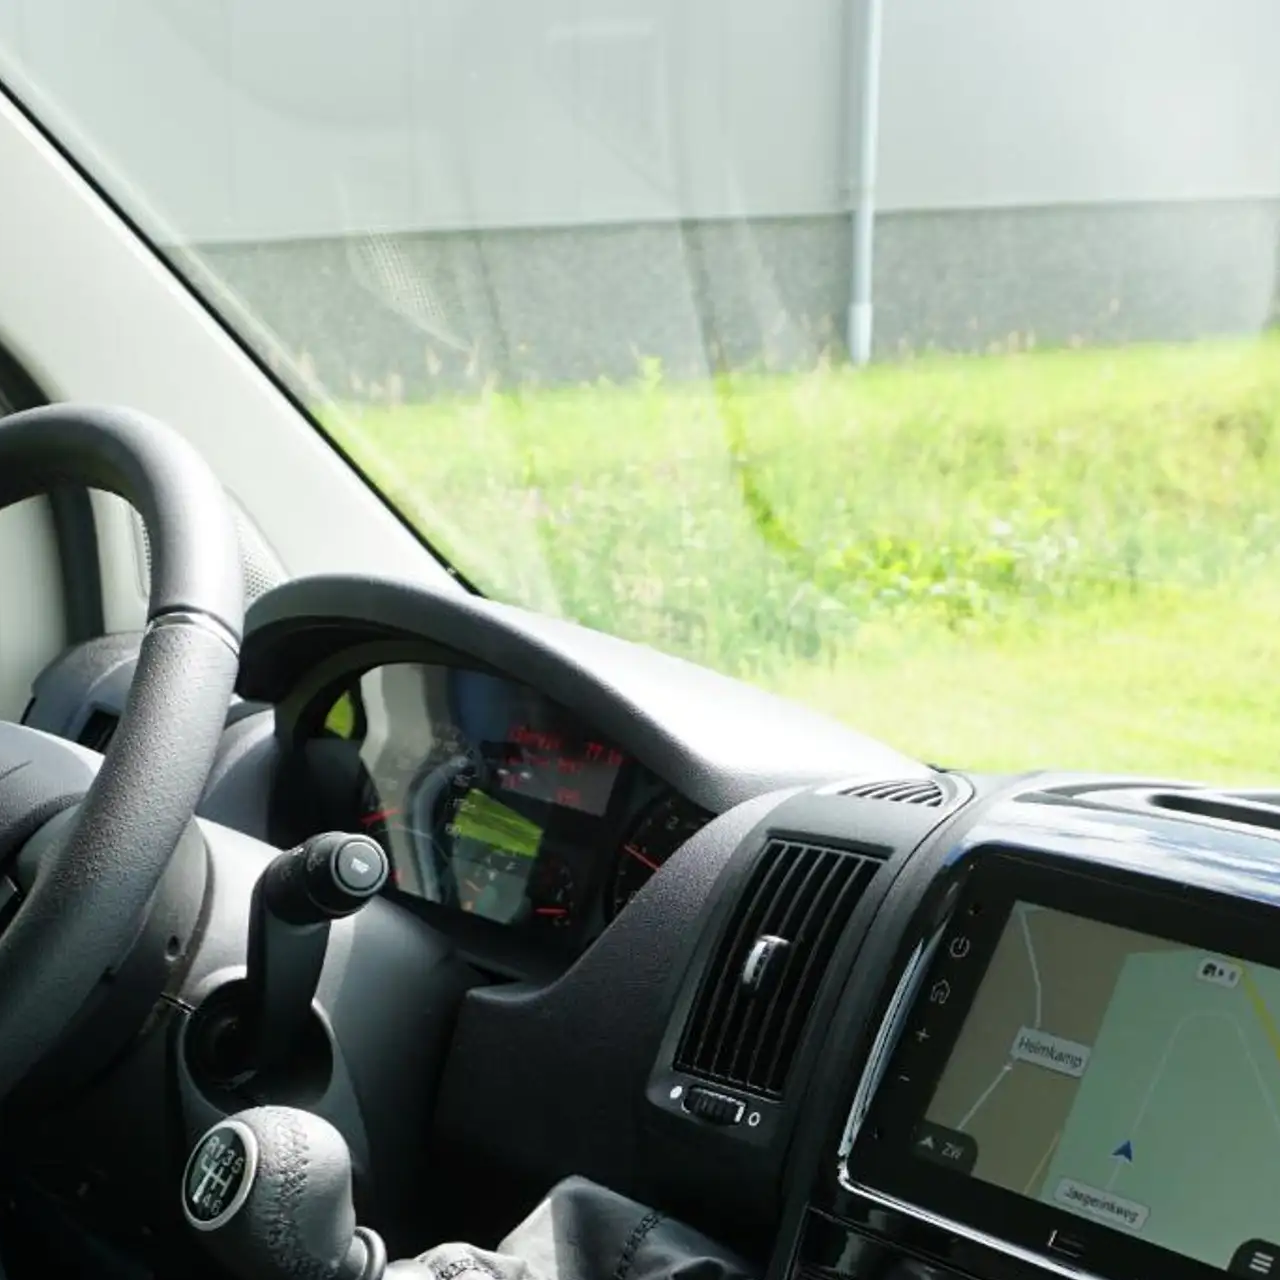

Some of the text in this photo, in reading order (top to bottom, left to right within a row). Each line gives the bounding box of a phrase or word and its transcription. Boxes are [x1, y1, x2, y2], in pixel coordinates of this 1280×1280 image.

[205, 1136, 244, 1174] R 1 3 5
